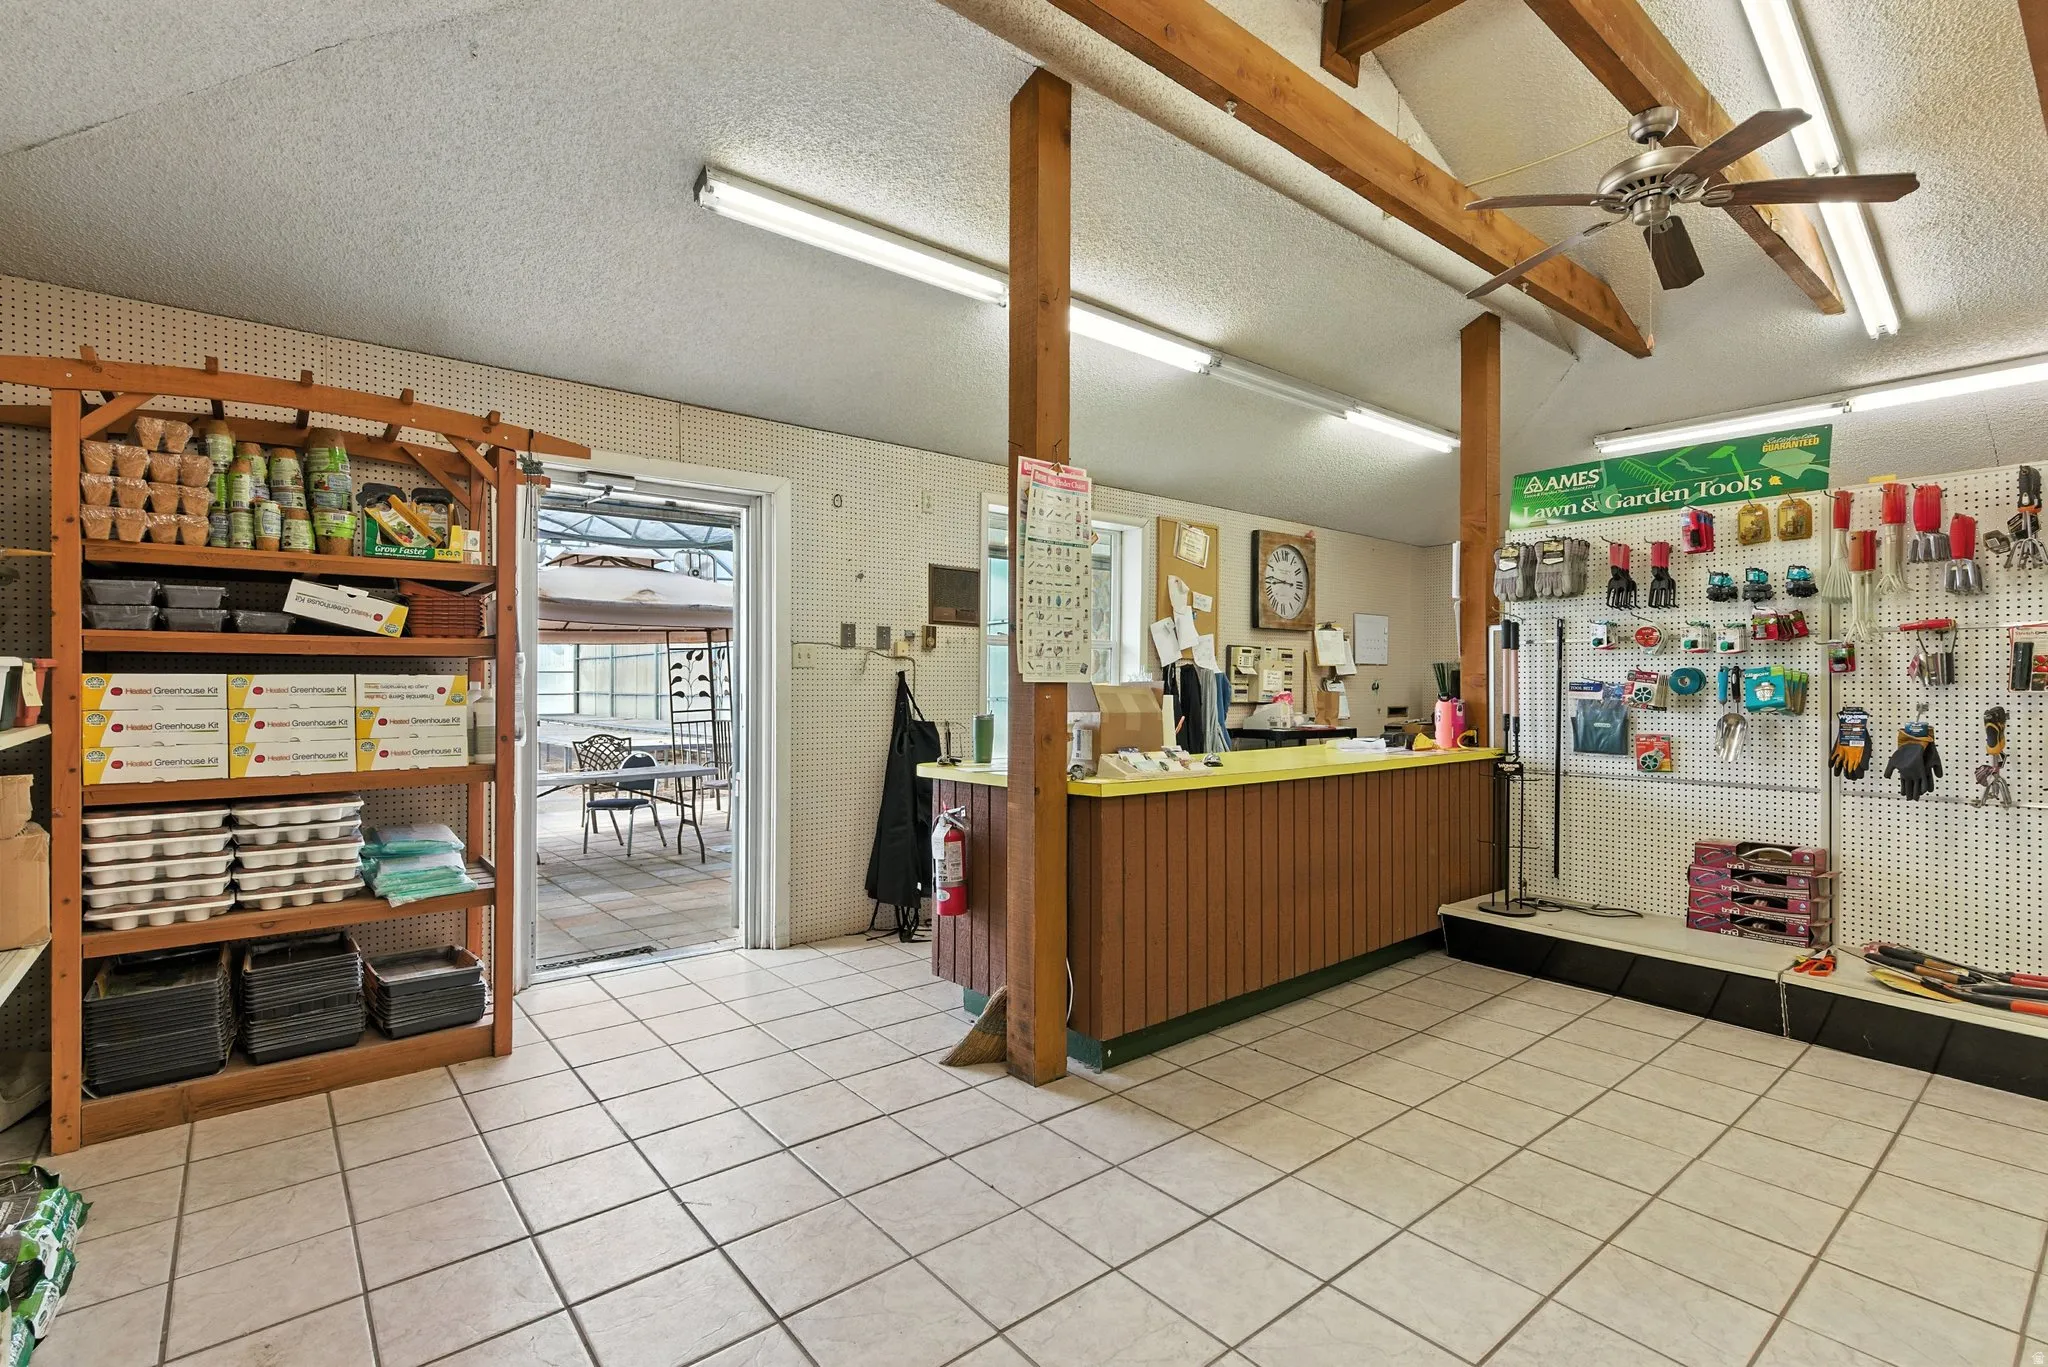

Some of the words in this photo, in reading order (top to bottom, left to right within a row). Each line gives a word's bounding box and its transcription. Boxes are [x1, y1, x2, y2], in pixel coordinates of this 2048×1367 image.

[1763, 437, 1820, 452] GUARANTEED
[1544, 469, 1600, 491] AMES
[1522, 503, 1578, 519] Lawn
[1581, 497, 1599, 513] &
[1605, 487, 1689, 509] Garden
[1693, 475, 1763, 497] Tools
[375, 545, 398, 554] Grow
[399, 546, 428, 556] Faster
[295, 595, 306, 604] Kit
[307, 599, 350, 615] Greenhouse
[125, 687, 152, 695] Heated
[153, 686, 206, 695] Greenhouse
[207, 686, 219, 695] Kit
[290, 686, 335, 694] Greenhouse
[337, 685, 347, 693] Kit
[154, 722, 206, 730] Greenhouse
[208, 721, 219, 730] Kit
[291, 719, 337, 727] Greenhouse
[338, 718, 348, 726] Kit
[291, 752, 337, 761] Greenhouse
[338, 751, 348, 759] Kit
[126, 759, 153, 767] Heated
[154, 757, 206, 767] Greenhouse
[207, 756, 219, 765] Kit
